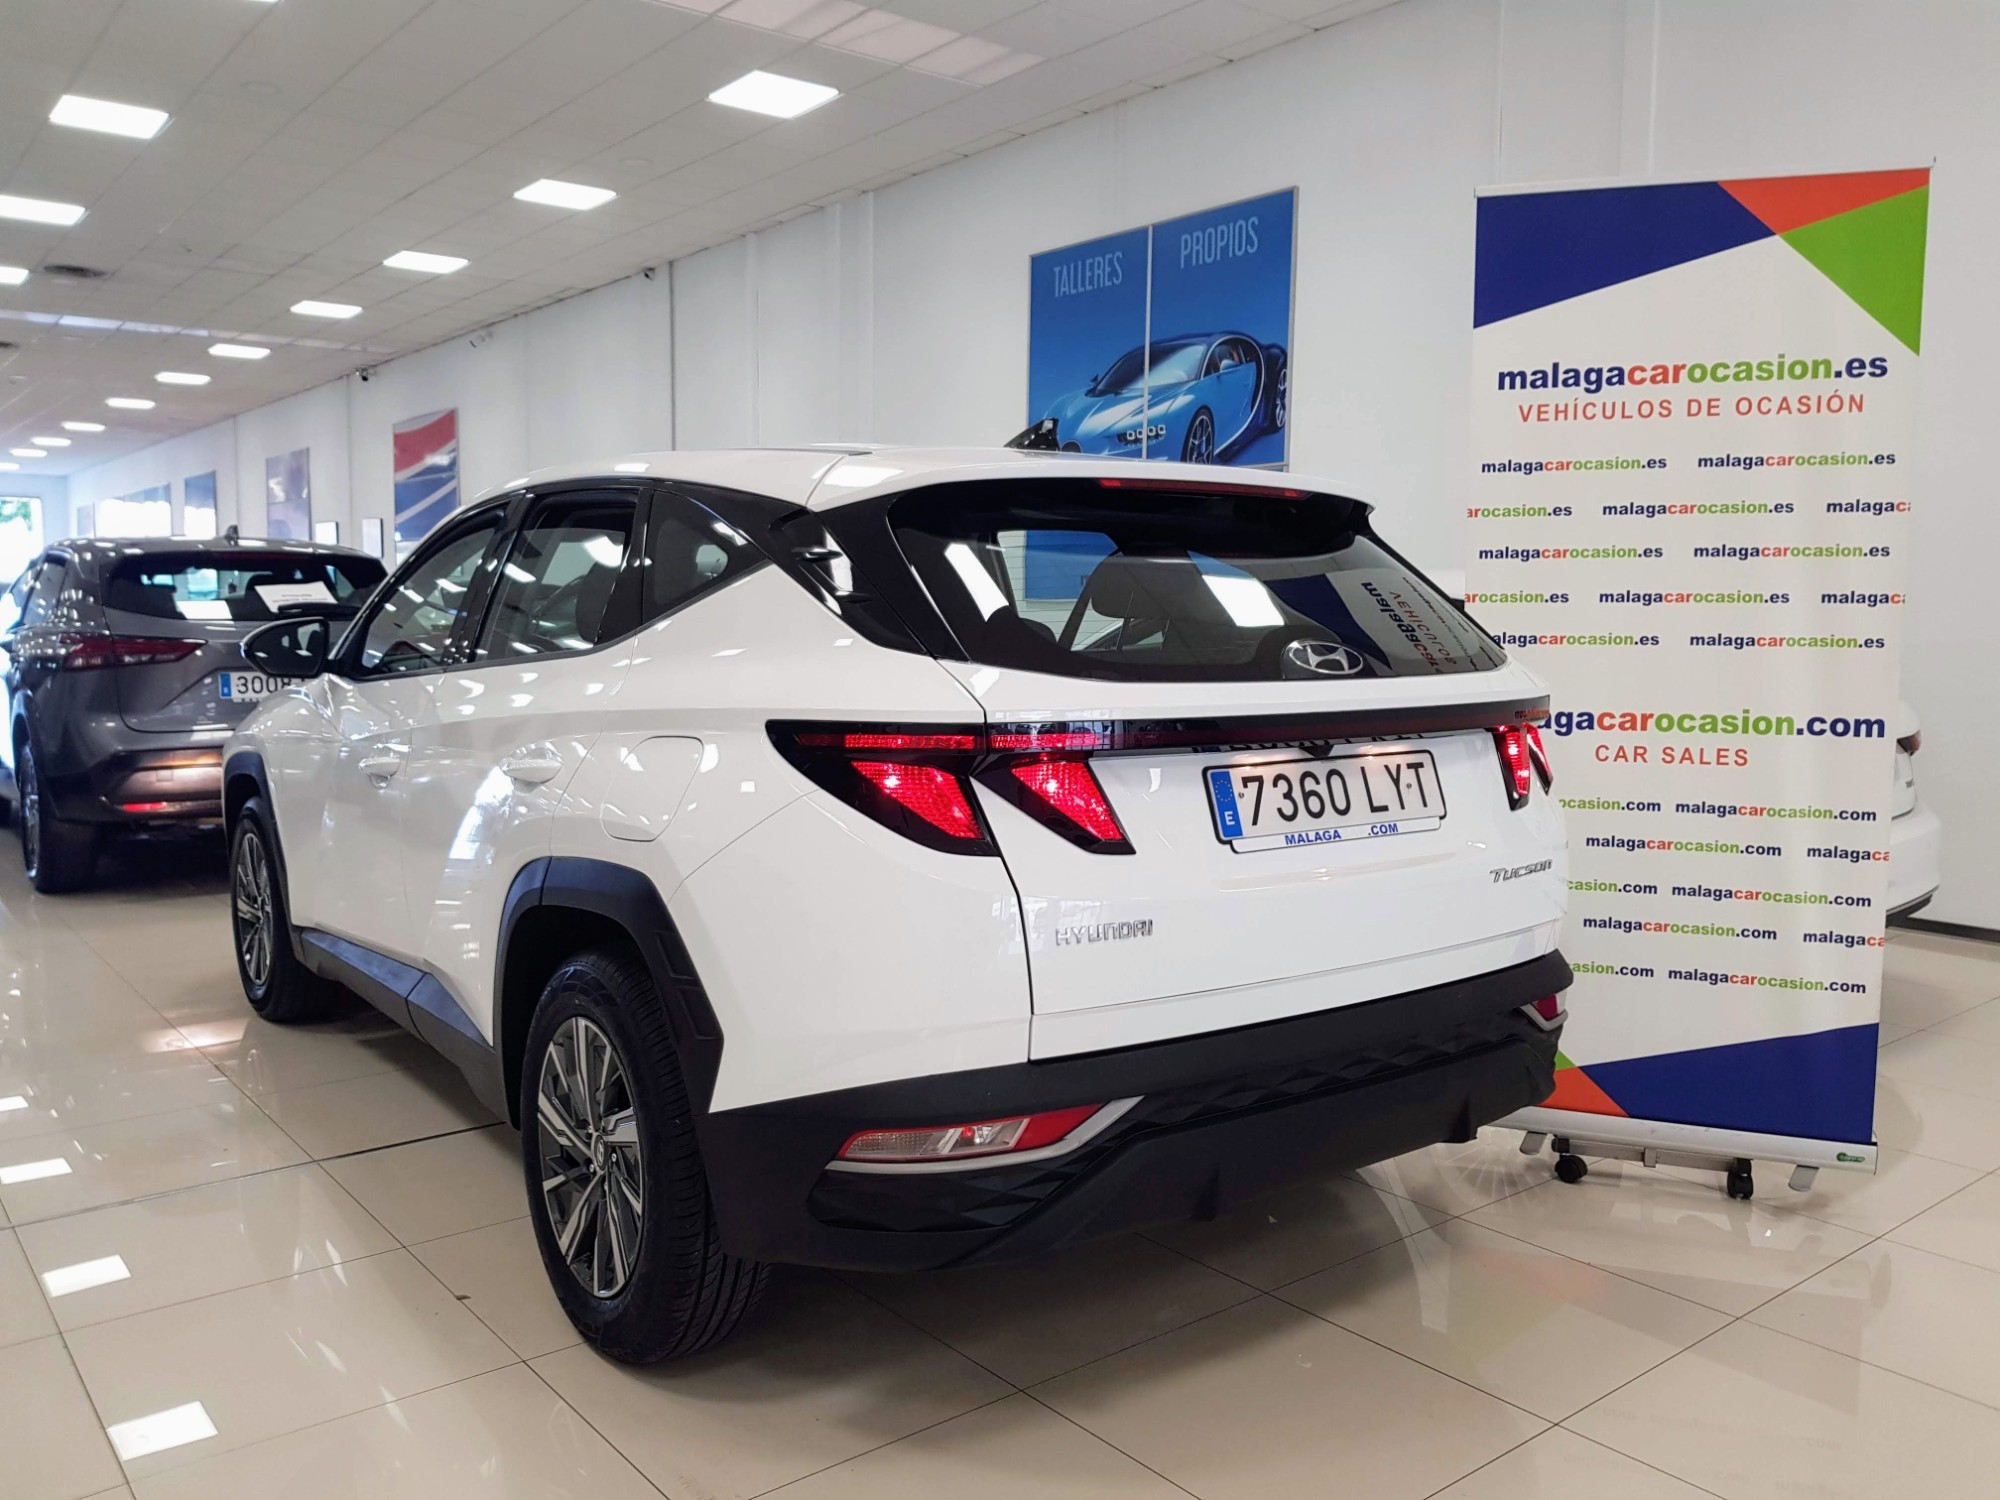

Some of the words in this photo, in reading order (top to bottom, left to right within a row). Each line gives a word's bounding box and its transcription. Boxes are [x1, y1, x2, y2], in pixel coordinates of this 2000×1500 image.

[1053, 251, 1123, 298] TALLERES
[1180, 216, 1259, 269] PROPIOS
[1498, 354, 1888, 394] malagacarocasion.es
[1518, 398, 1673, 423] VEHÍCULOS
[1687, 398, 1721, 417] DE
[1735, 389, 1864, 417] OCASIÓN
[1481, 456, 1667, 475] malagacarocasion.es
[1698, 452, 1896, 470] malagacarocasion.es
[1602, 500, 1794, 518] malagacarocasion.es
[1478, 545, 1664, 562] malagacarocasion.es
[1694, 544, 1890, 561] malagacarocasion.es
[1599, 590, 1790, 606] malagacarocasion.es
[1492, 632, 1660, 648] alagacarocasion.es
[1689, 633, 1886, 650] malagacarocasion.es
[1595, 745, 1648, 764] CAR
[1662, 746, 1749, 767] SALES
[1241, 768, 1351, 826] 7360
[1360, 761, 1425, 814] LYT
[1224, 811, 1235, 826] E
[1675, 801, 1876, 821] malagacarocasion.com
[1284, 829, 1342, 845] MALAGA
[1367, 822, 1399, 836] .COM
[1586, 835, 1782, 857] malagacarocasion.com
[1671, 884, 1871, 907] malagacarocasion.com
[1055, 919, 1153, 946] HYUNDAI
[1583, 915, 1777, 940] malagacarocasion.com
[1569, 961, 1655, 977] asion.com
[1668, 967, 1867, 994] malagacarocasion.com
